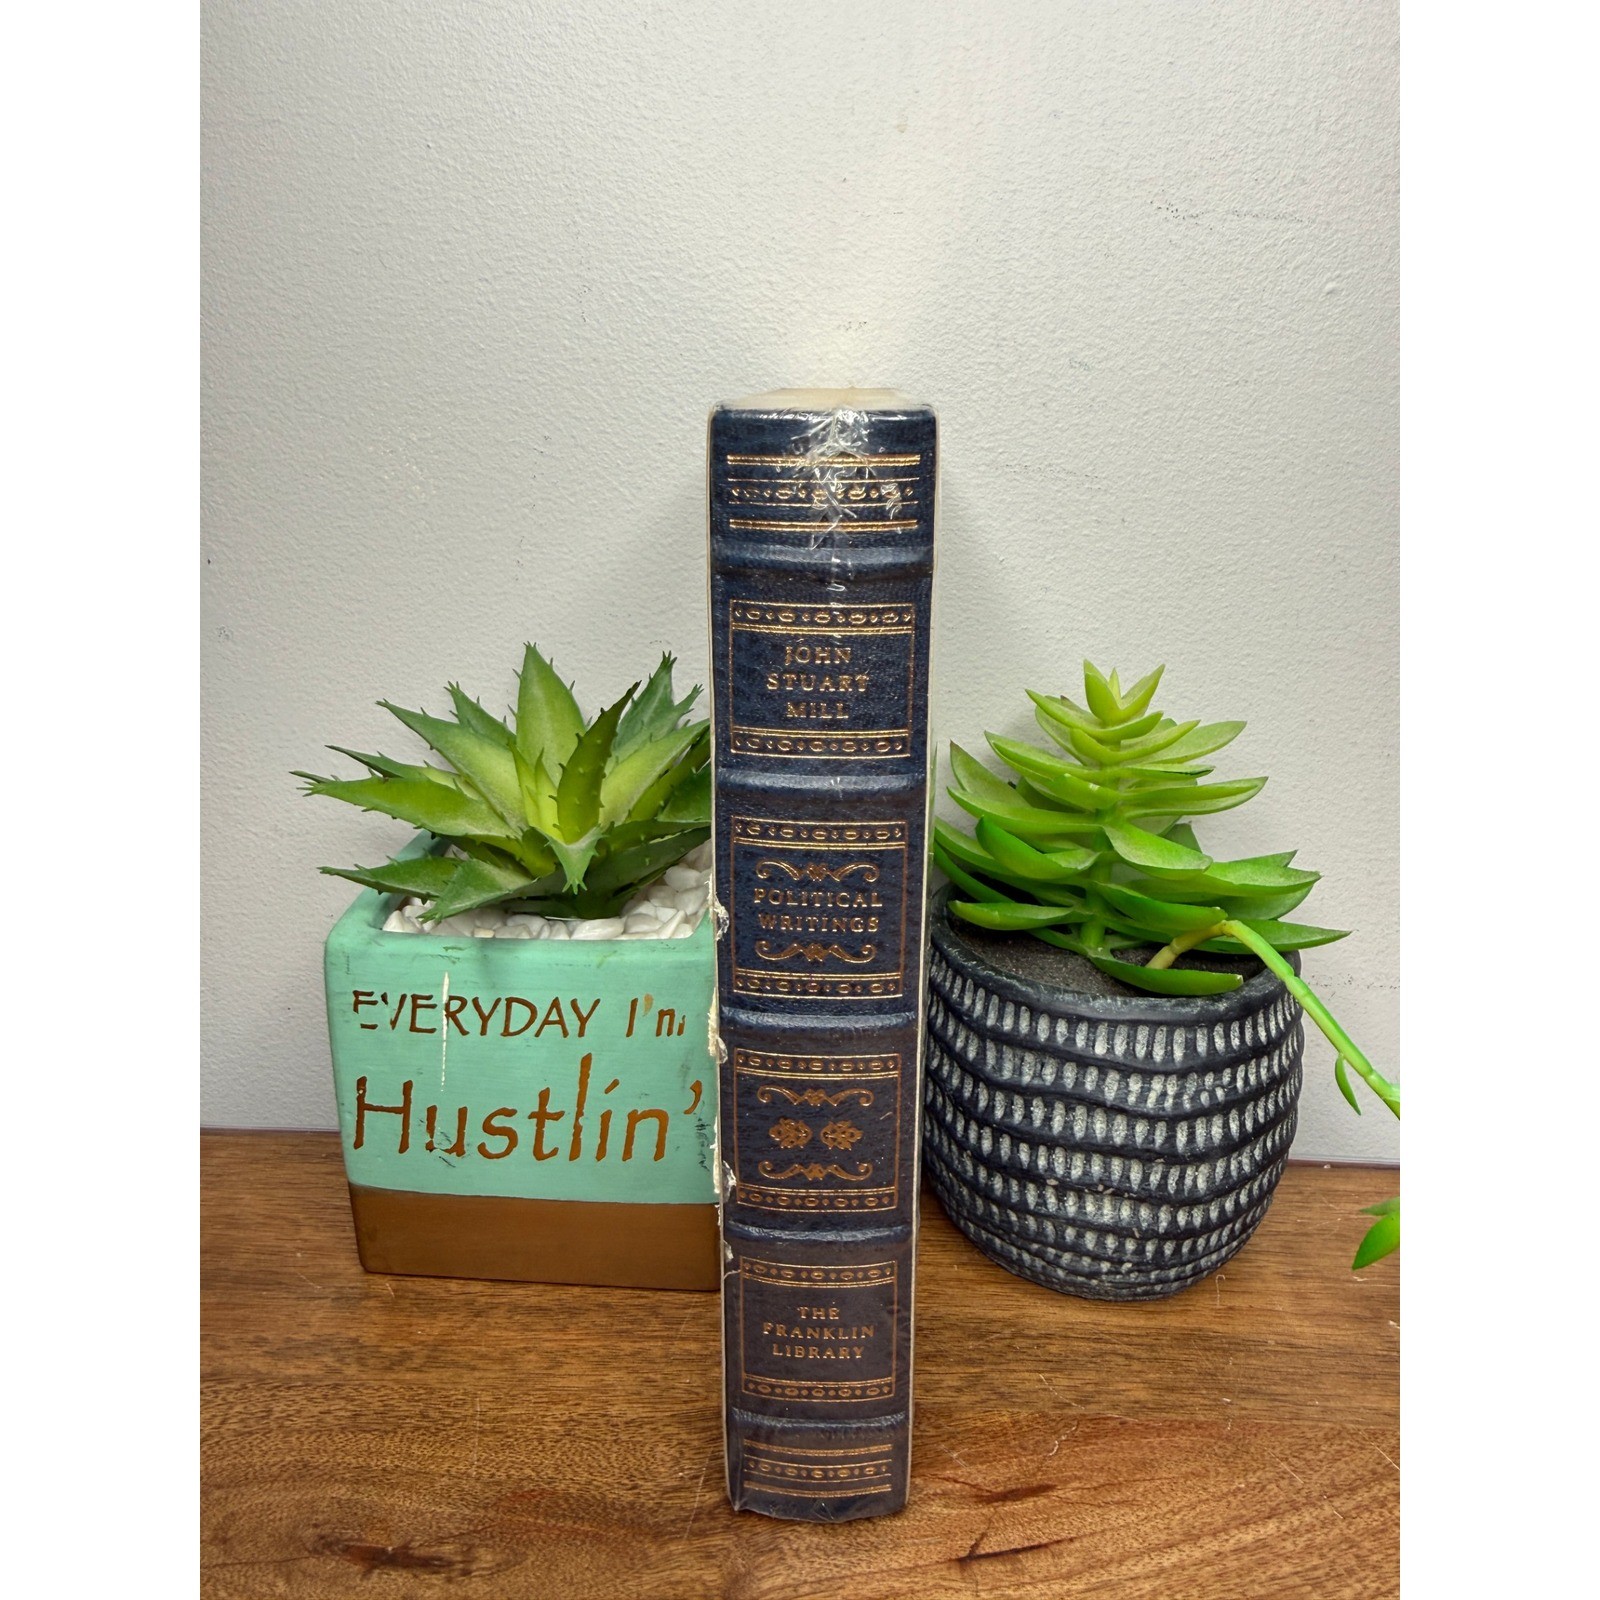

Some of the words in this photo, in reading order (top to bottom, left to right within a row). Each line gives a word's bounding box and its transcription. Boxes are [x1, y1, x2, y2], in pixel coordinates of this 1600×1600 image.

[784, 646, 852, 666] JOHN
[766, 673, 870, 692] STUART
[786, 702, 849, 719] MILL
[754, 887, 883, 908] POLITICAL
[758, 913, 880, 933] WRITINGS
[352, 989, 601, 1038] EVERYDAY
[625, 992, 687, 1038] I'm
[353, 1052, 703, 1163] Hustlin'
[797, 1306, 841, 1320] THE
[762, 1322, 875, 1340] FRANKLIN
[772, 1343, 865, 1359] LIBRARY
